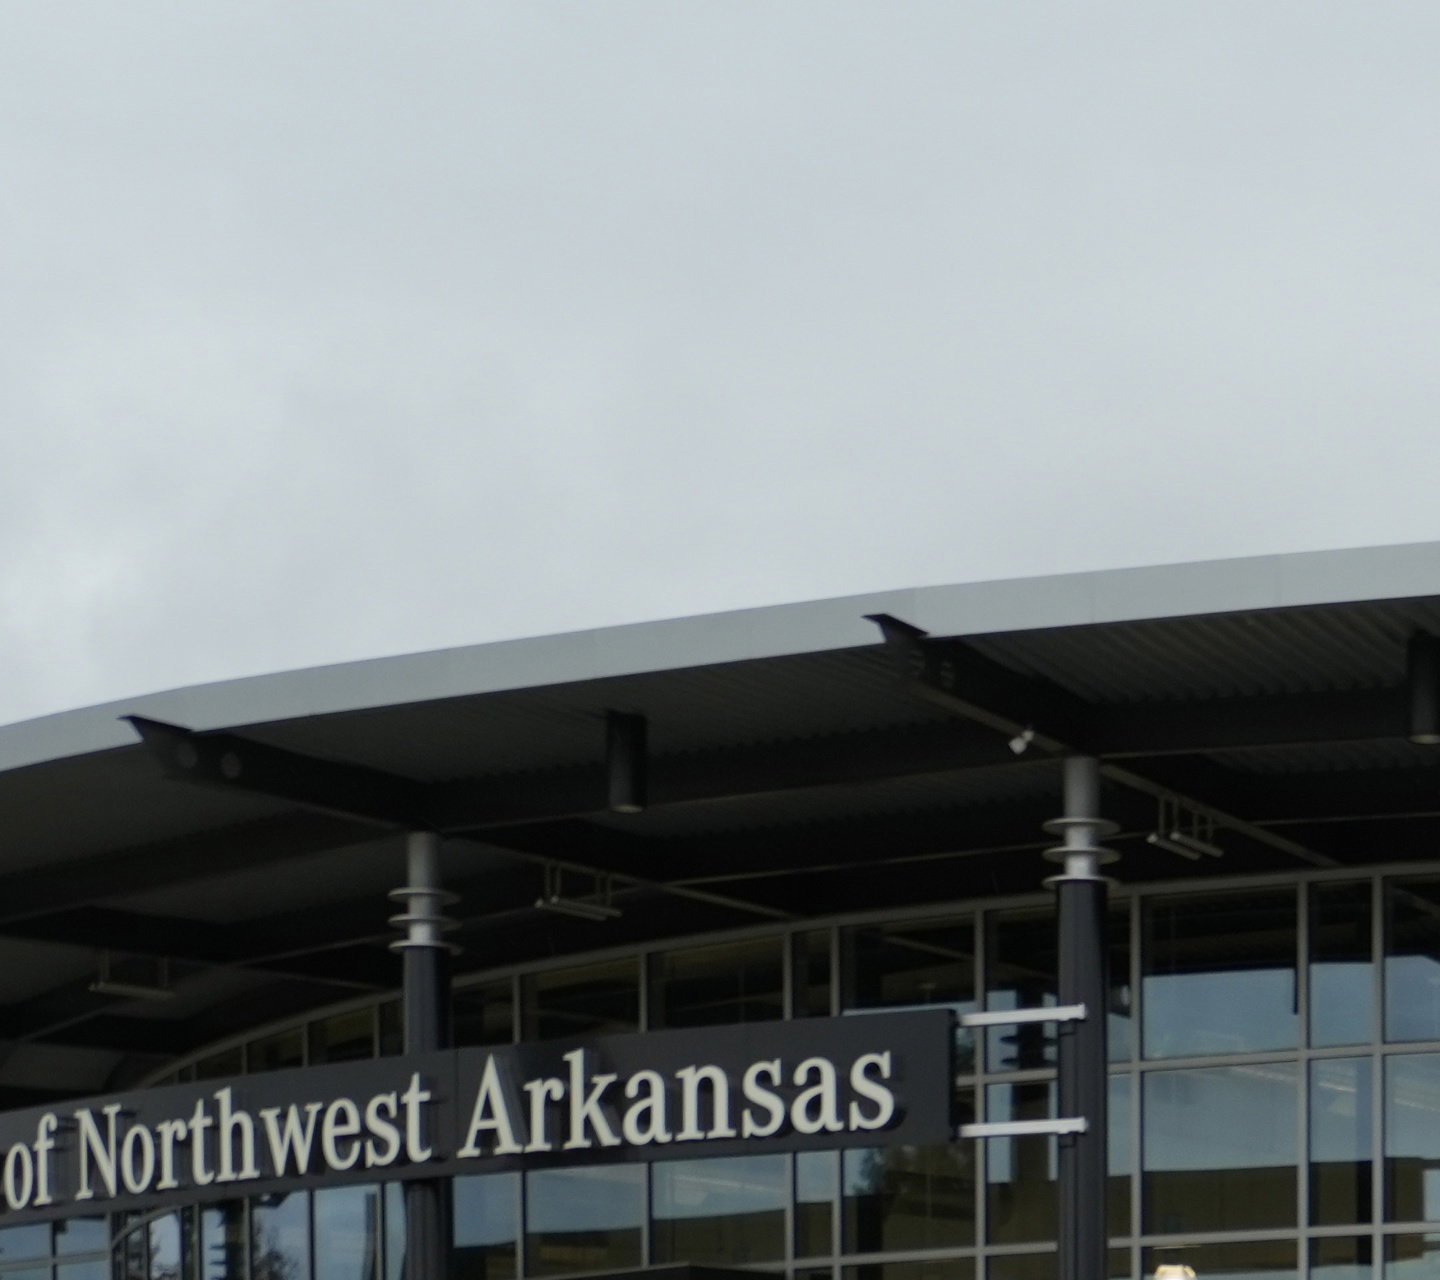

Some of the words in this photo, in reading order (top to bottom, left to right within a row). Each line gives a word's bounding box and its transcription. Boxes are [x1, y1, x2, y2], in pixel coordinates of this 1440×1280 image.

[3, 1112, 58, 1210] of
[74, 1072, 432, 1200] Northwest
[457, 1048, 896, 1160] Arkansas
